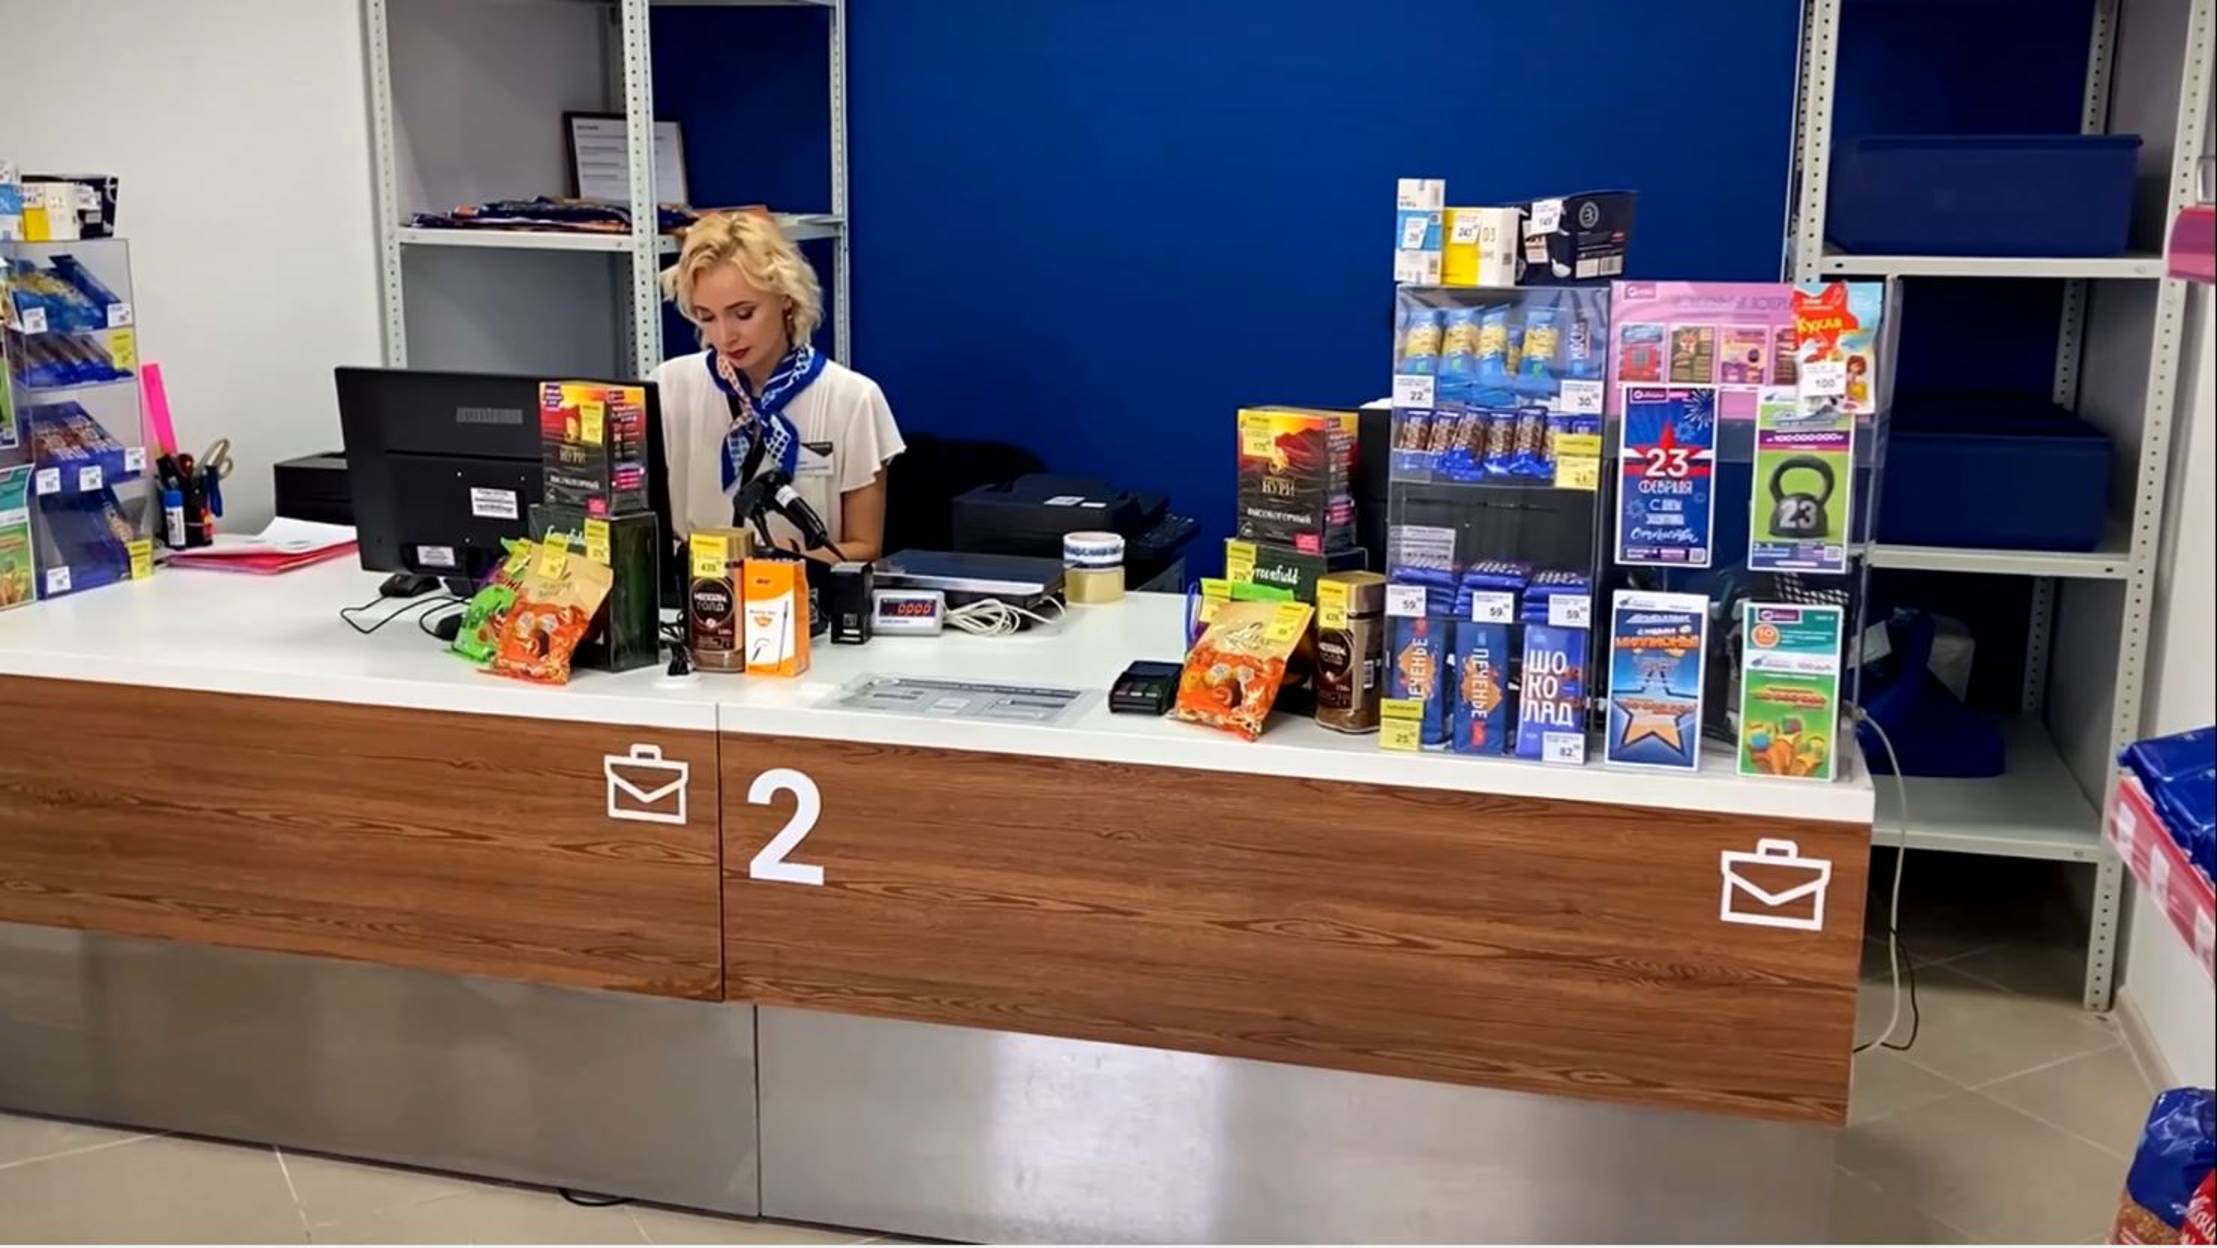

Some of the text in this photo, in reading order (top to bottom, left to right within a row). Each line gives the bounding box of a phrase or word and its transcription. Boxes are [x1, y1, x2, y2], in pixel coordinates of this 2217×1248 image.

[1645, 448, 1689, 477] 23
[1779, 500, 1818, 529] 23
[1530, 649, 1567, 674] ШО
[1471, 647, 1490, 719] ПЕЧЕНЬЕ
[1526, 674, 1559, 699] КО
[1523, 700, 1574, 727] ЛАД
[747, 768, 824, 886] 2
